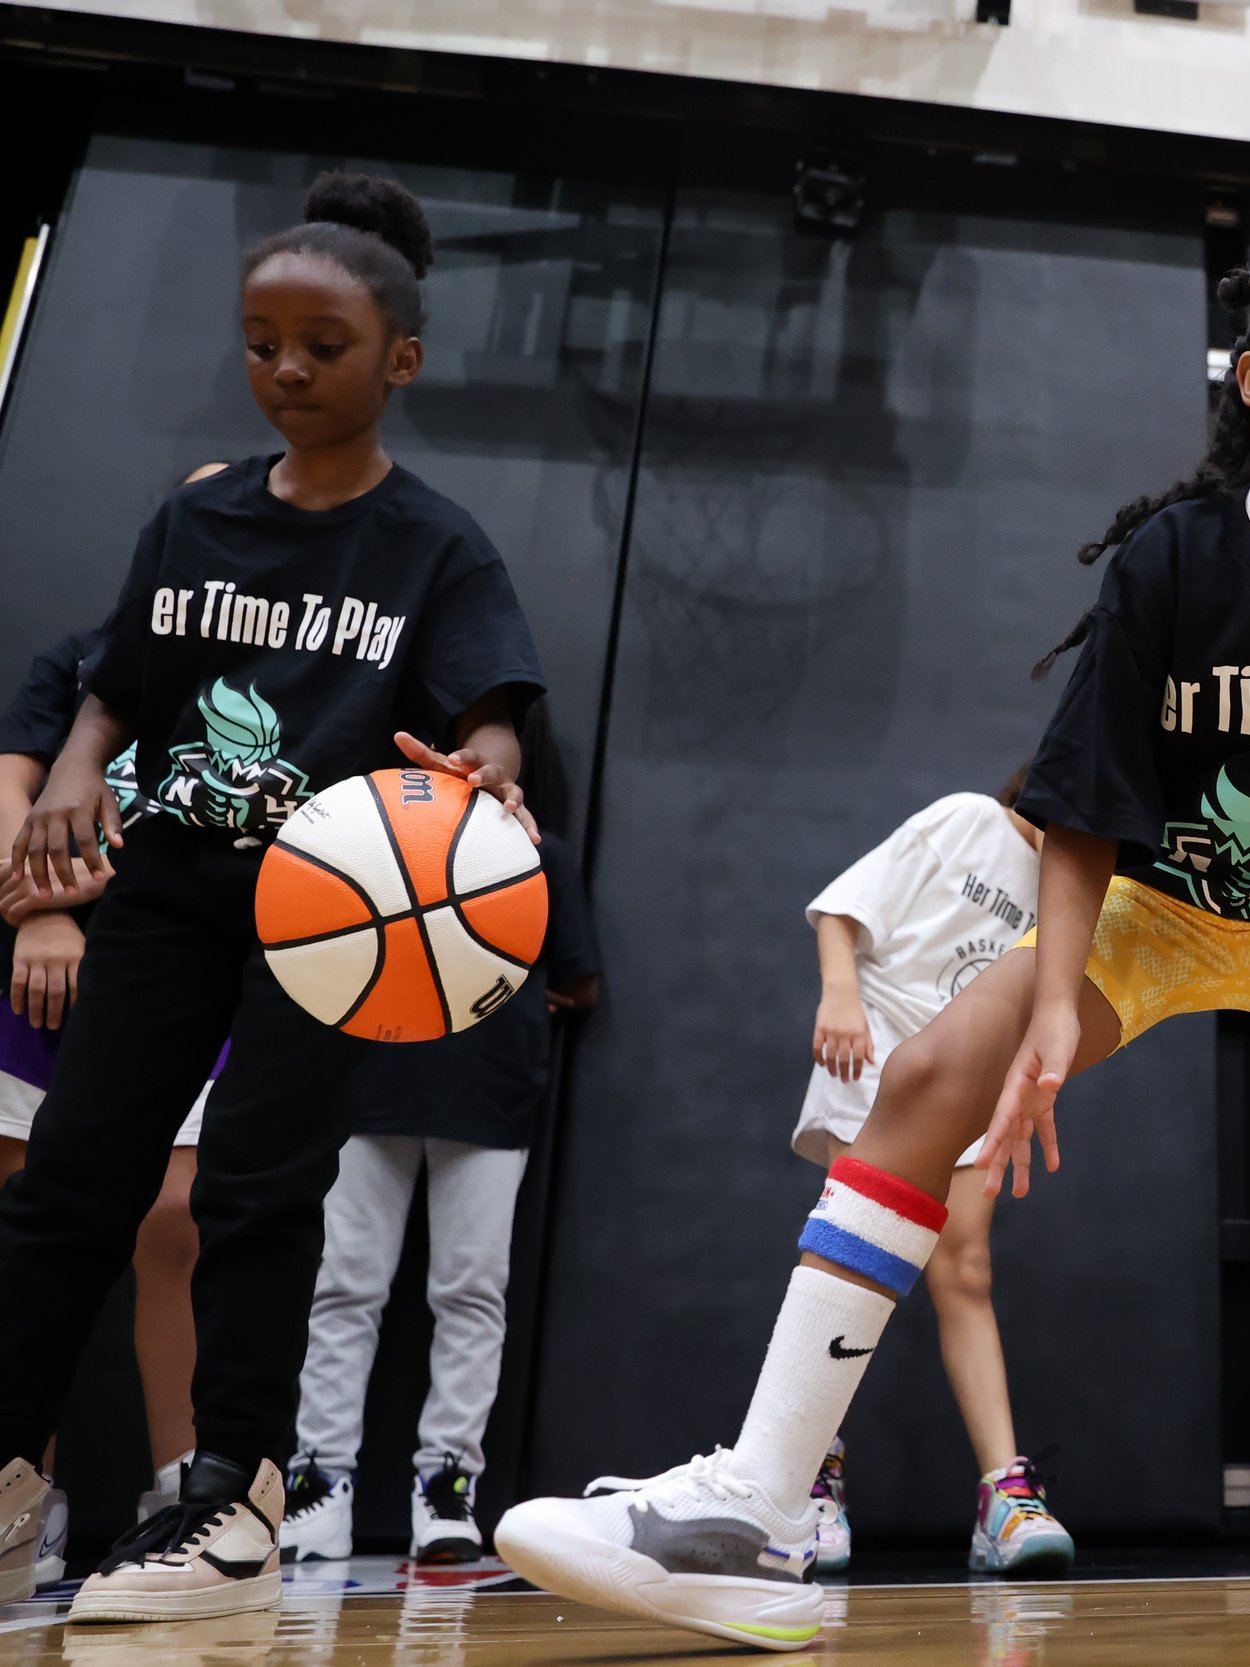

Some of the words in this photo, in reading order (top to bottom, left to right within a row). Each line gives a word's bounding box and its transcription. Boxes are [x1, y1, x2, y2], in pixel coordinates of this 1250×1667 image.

[151, 587, 194, 637] er
[201, 580, 290, 649] Time
[295, 593, 332, 651] To
[331, 596, 406, 670] Play
[1160, 674, 1200, 734] er
[961, 873, 990, 907] Her
[989, 888, 1023, 930] Time
[1023, 912, 1037, 936] T
[955, 939, 1005, 959] BASKE
